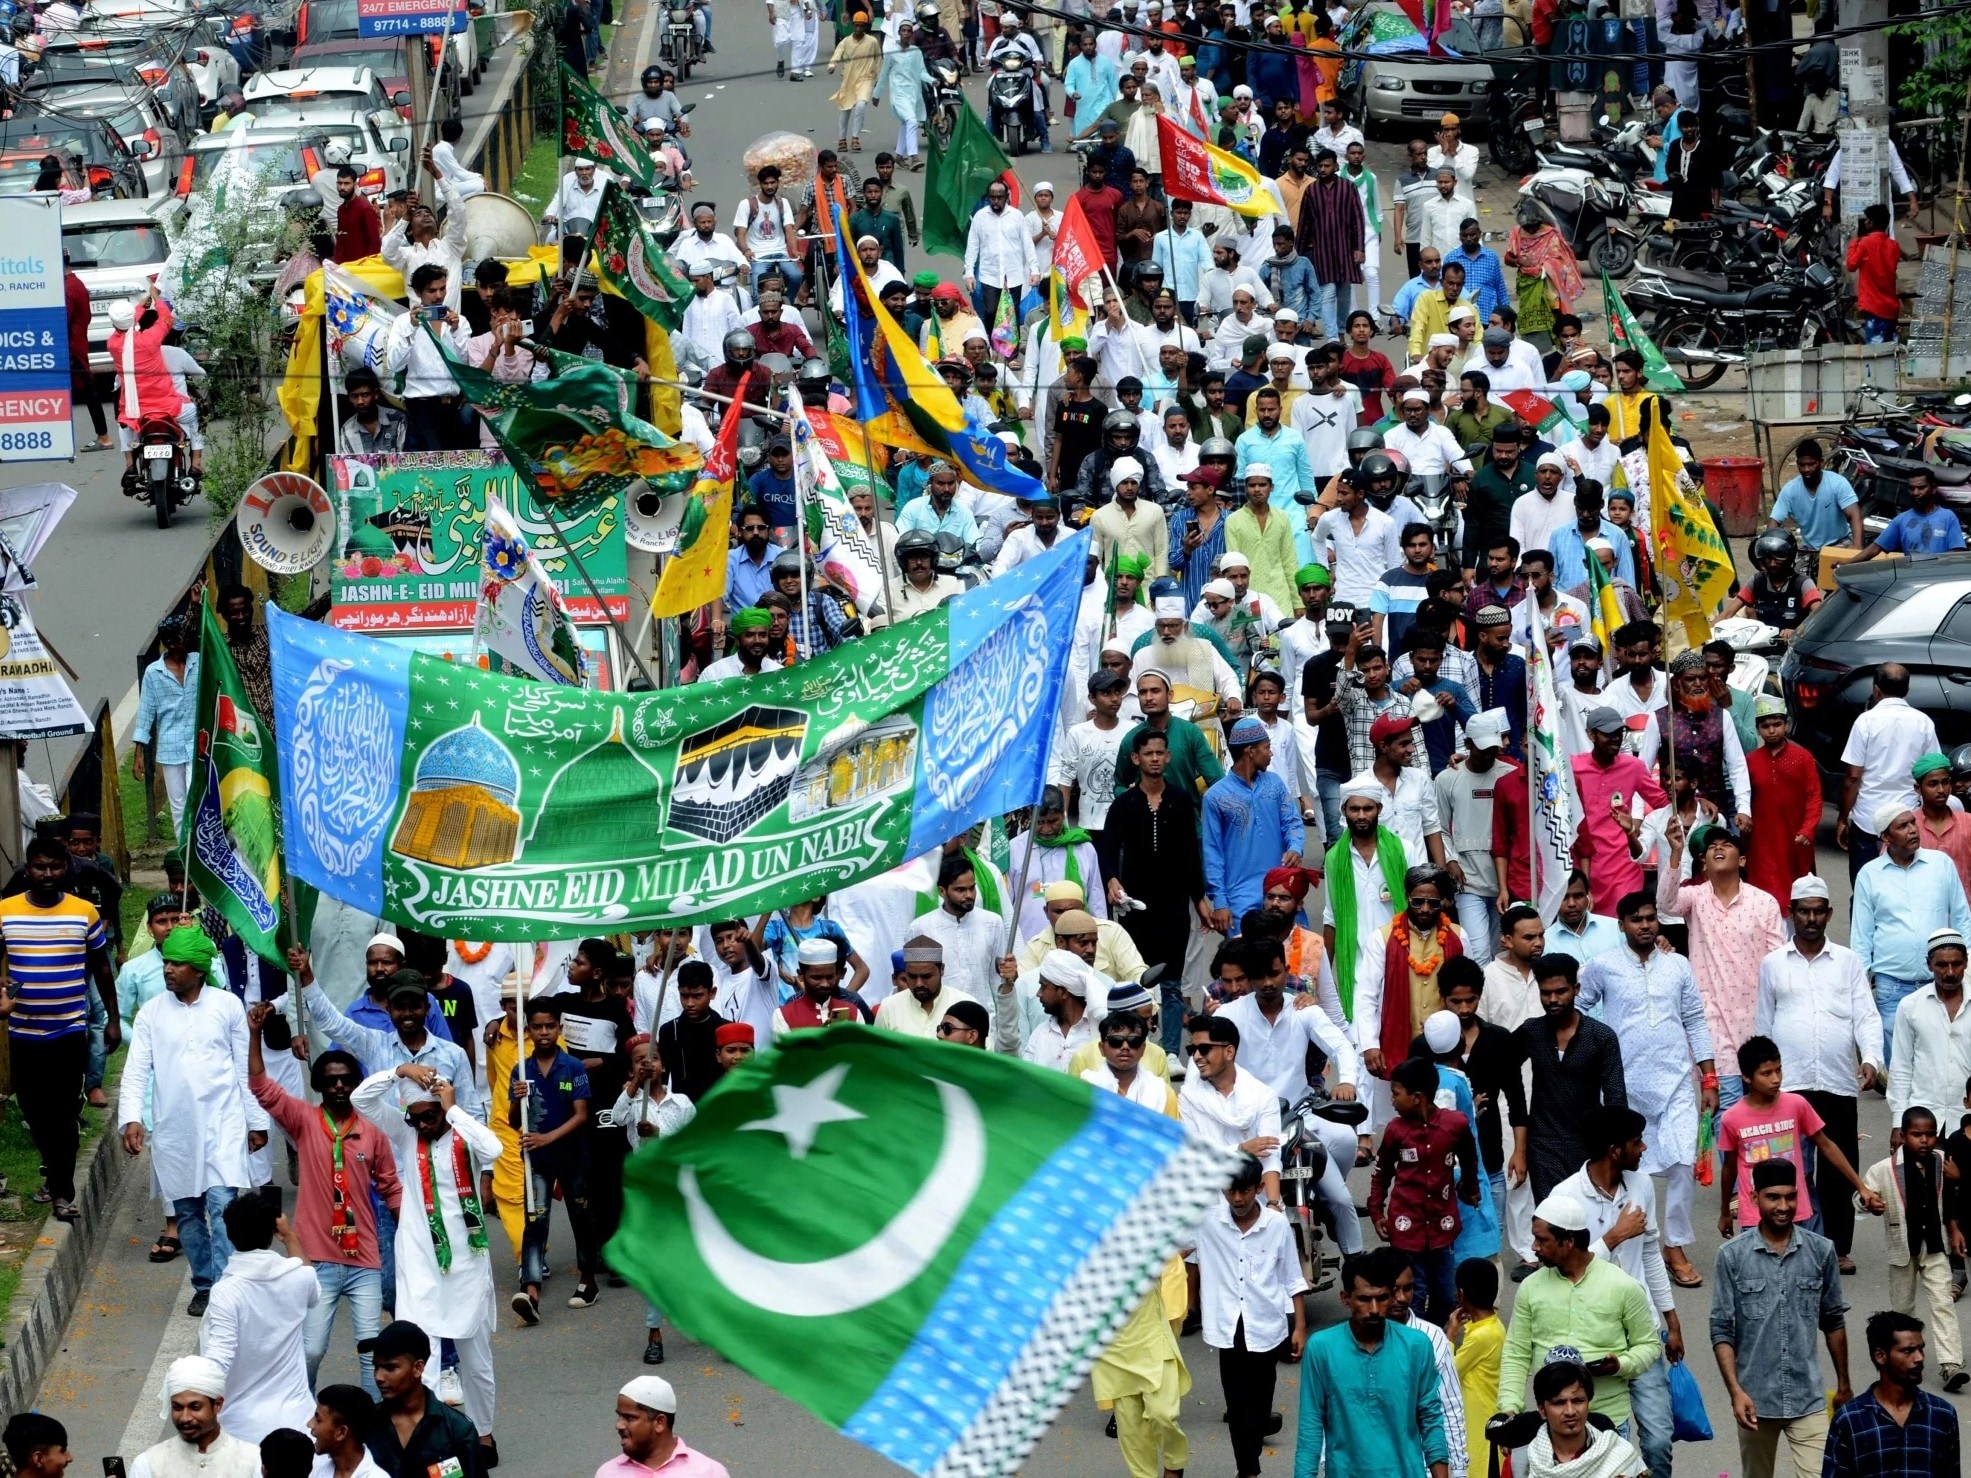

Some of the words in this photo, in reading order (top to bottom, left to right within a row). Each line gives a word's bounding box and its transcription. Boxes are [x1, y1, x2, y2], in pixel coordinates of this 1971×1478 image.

[362, 3, 384, 13] 24/7
[374, 19, 409, 31] 97714
[9, 281, 46, 291] RANCHI
[0, 331, 36, 348] ICS
[41, 331, 55, 346] &
[250, 523, 287, 563] SOUND
[300, 524, 326, 561] LIGHT
[640, 538, 665, 546] Ranchi
[606, 577, 625, 585] Alaihi
[418, 583, 445, 600] EID
[449, 582, 477, 598] MIL
[1788, 597, 1796, 608] 6
[1326, 608, 1354, 621] BOY
[47, 728, 74, 738] Ground
[431, 875, 561, 911] JASHNE
[559, 867, 627, 911] EID
[630, 846, 746, 903] MILAD
[750, 840, 797, 879] UN
[800, 818, 865, 869] NABI
